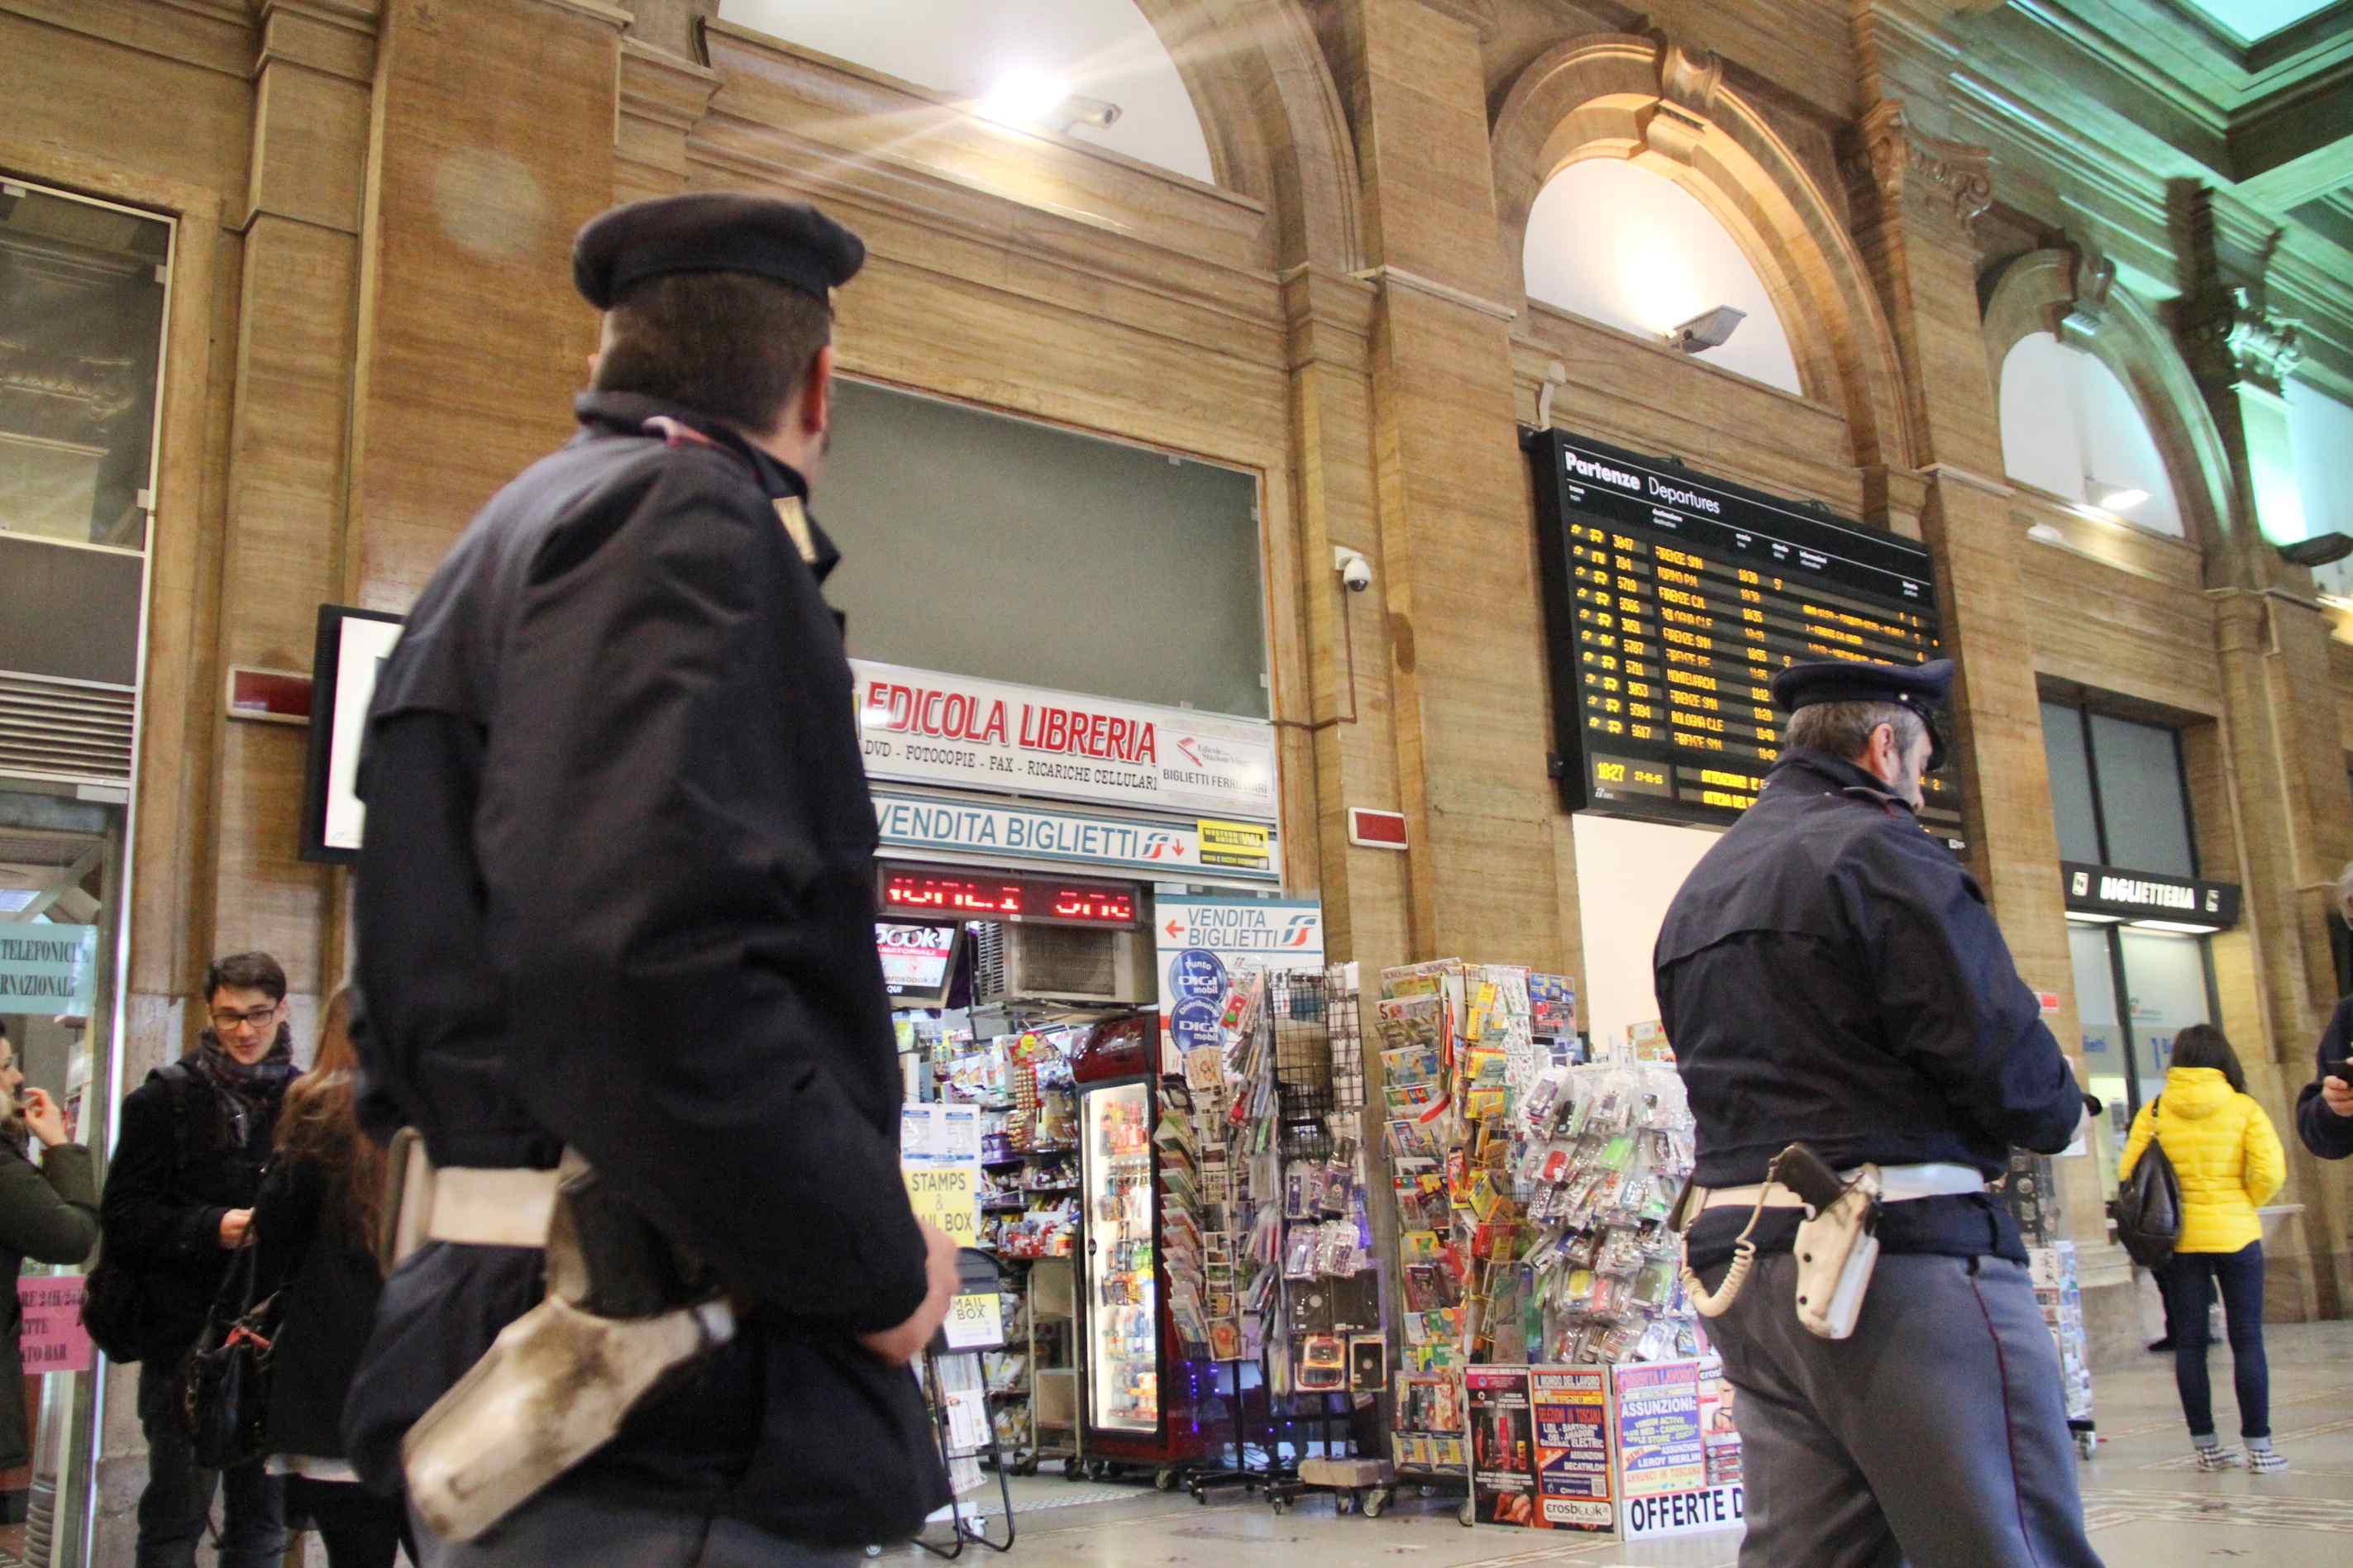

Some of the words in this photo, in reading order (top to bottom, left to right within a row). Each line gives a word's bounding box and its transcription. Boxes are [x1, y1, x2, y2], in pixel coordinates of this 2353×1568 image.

[1565, 451, 1641, 491] Partenze
[1649, 476, 1721, 514] Departures
[868, 682, 1009, 746] EDICOLA
[1019, 703, 1157, 765] LIBRERIA
[865, 739, 891, 757] DVD
[906, 745, 976, 768] FOTOCOPIE
[990, 756, 1014, 773] FAX
[1027, 760, 1091, 784] RICARICHE
[1094, 769, 1157, 791] CELLULARI
[1163, 768, 1209, 786] BIGLIETTI
[1006, 817, 1138, 858] BIGLIETTI
[2100, 876, 2195, 909] BIGLIETTERIA
[1187, 908, 1266, 927] VENDITA
[1188, 927, 1278, 948] BIGLIETTI
[1178, 975, 1217, 986] DIGI
[1193, 985, 1218, 994] mobil
[1193, 1032, 1219, 1041] mobil
[912, 1173, 966, 1191] STAMPS
[945, 1213, 972, 1232] BOX
[952, 1296, 986, 1308] MAIL
[957, 1308, 986, 1320] BOX
[1638, 1456, 1667, 1468] LEROY
[1631, 1489, 1725, 1531] OFFERTE
